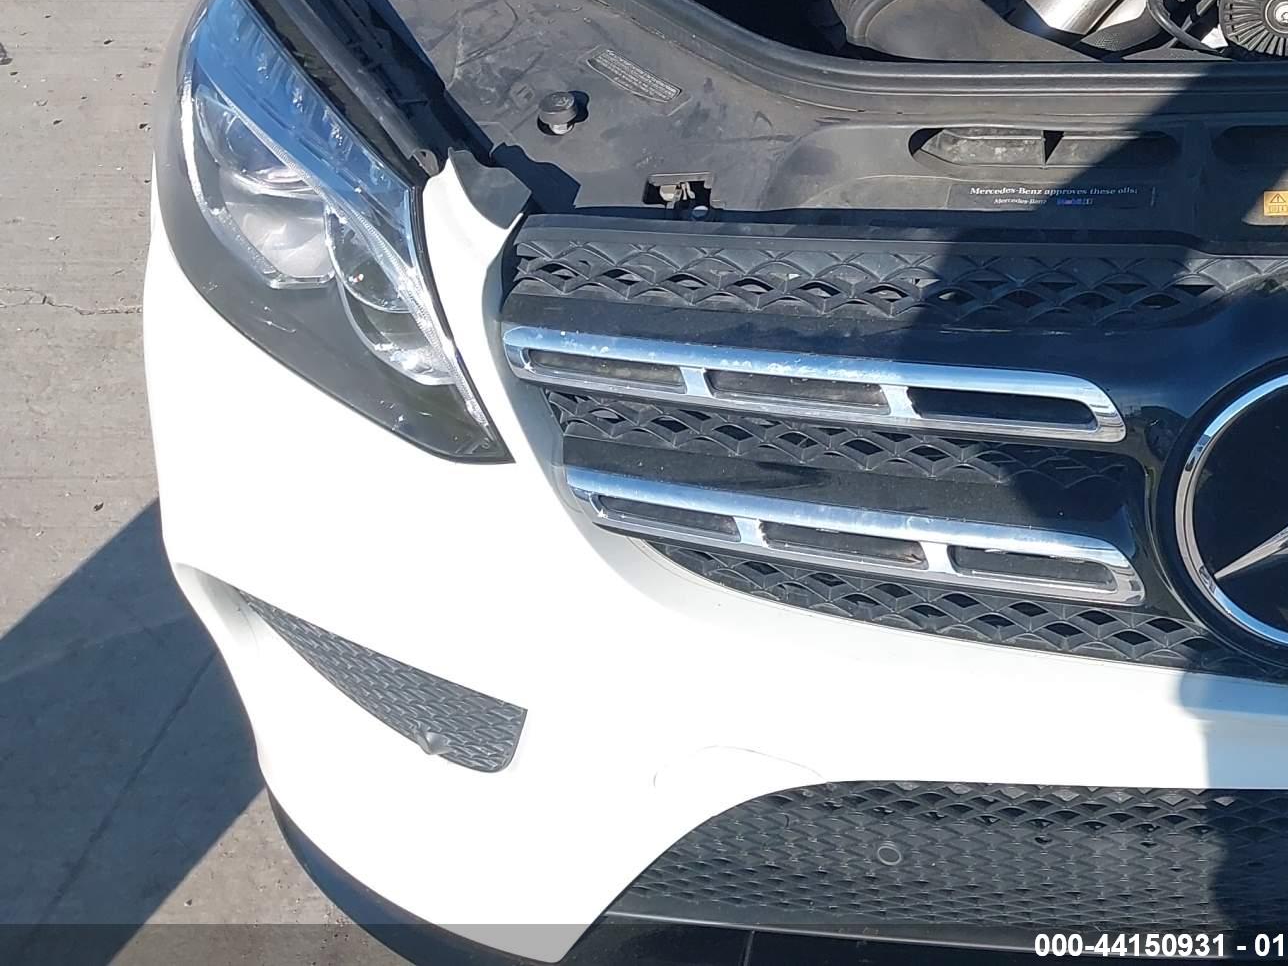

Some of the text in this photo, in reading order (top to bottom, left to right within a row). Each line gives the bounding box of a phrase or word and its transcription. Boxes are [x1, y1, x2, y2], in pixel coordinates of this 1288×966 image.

[969, 187, 1043, 195] Mercedes-Benz
[1043, 189, 1088, 197] approves
[1089, 187, 1116, 195] these
